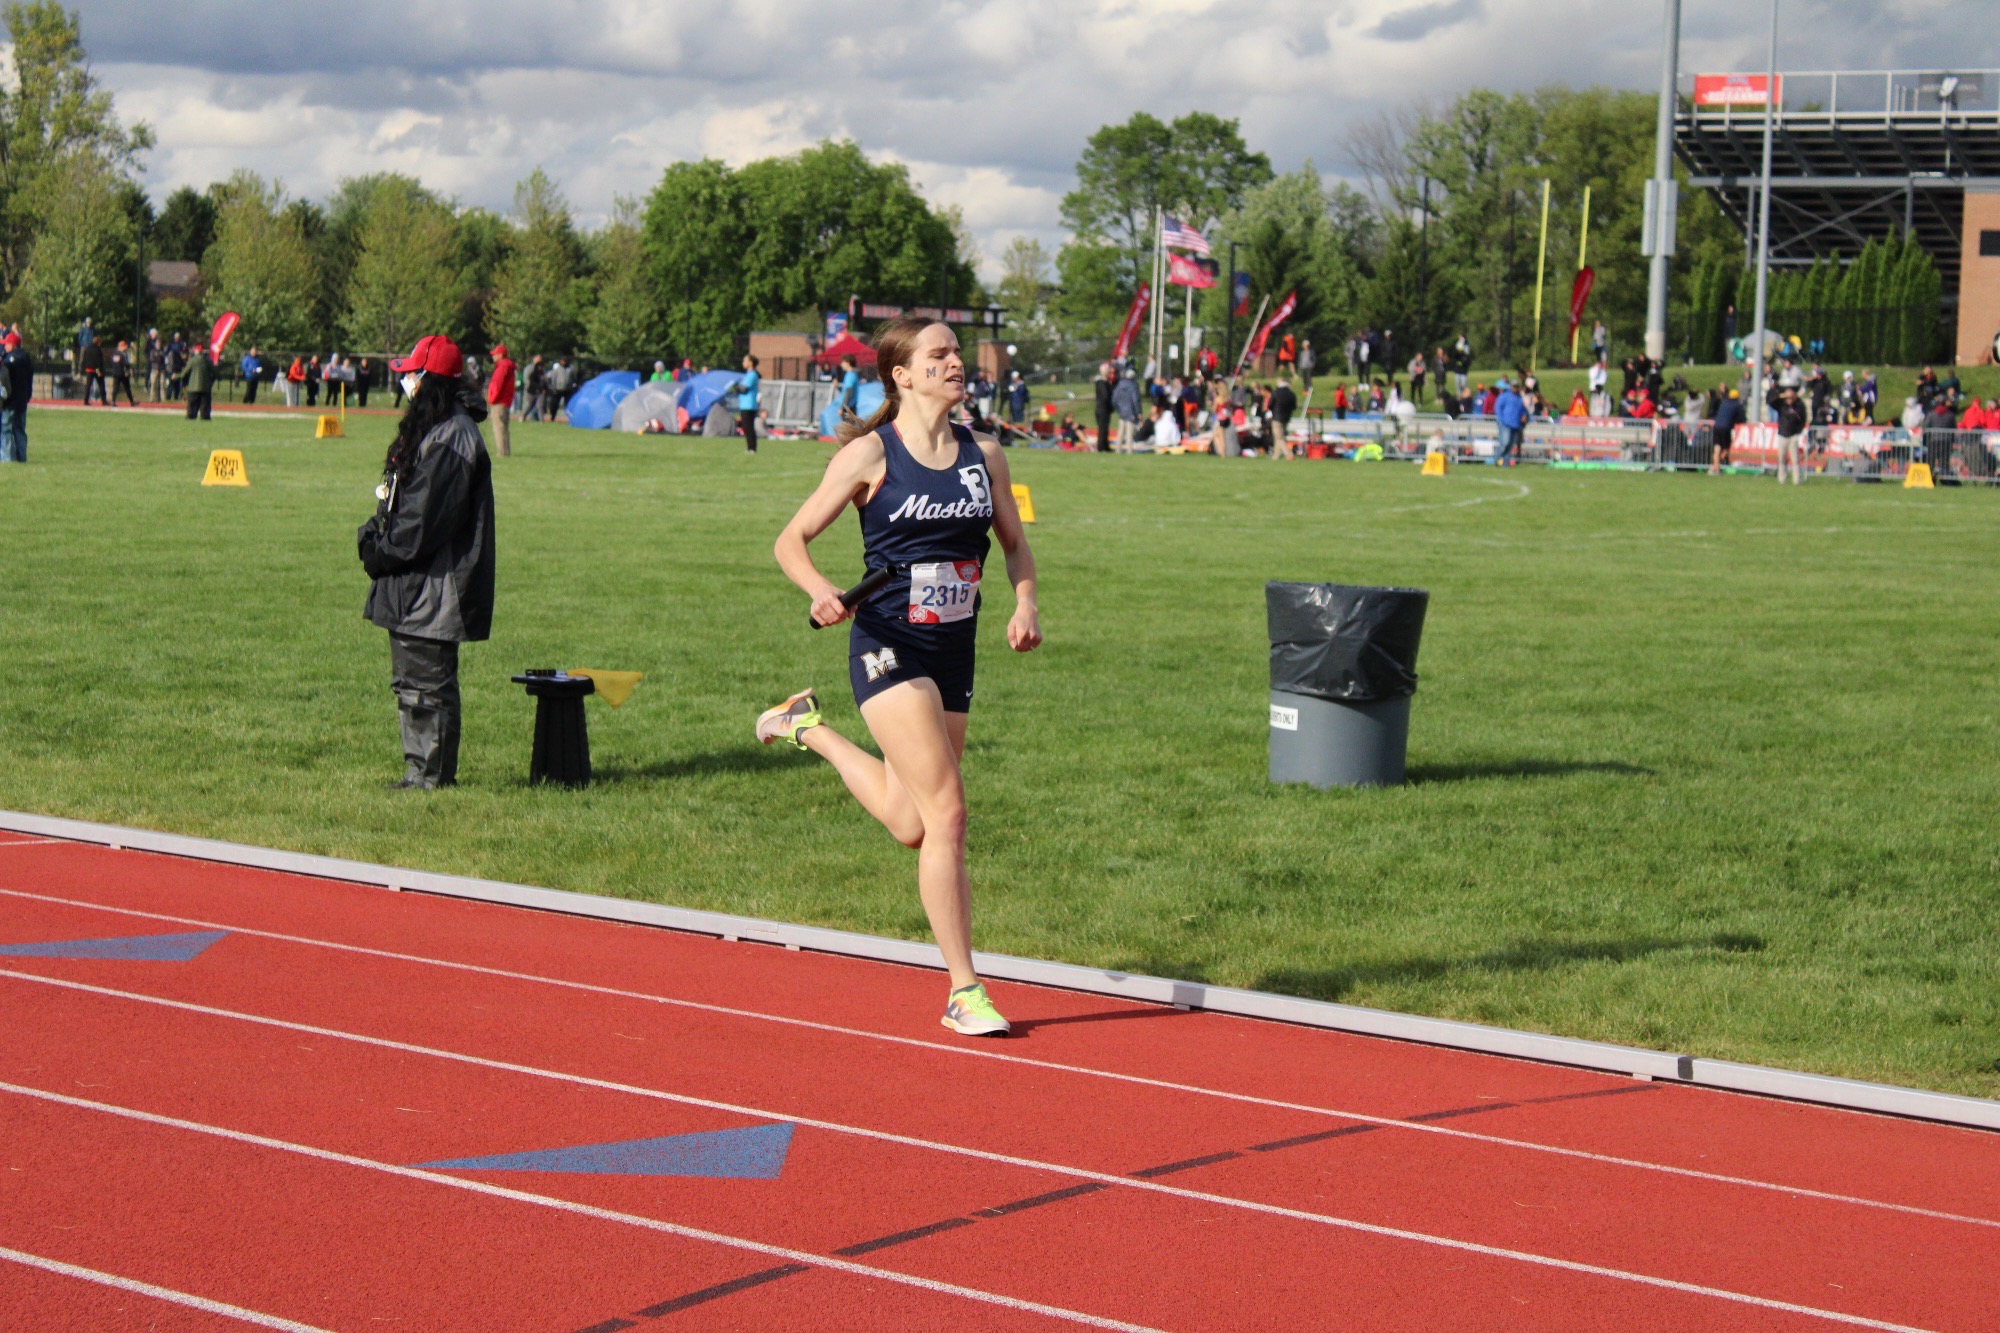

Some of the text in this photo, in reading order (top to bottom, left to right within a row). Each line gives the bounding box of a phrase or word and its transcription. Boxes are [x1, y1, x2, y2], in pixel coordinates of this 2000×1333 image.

[926, 366, 937, 378] M
[213, 456, 239, 470] 50m
[214, 466, 235, 477] 164
[967, 467, 989, 504] 3
[922, 583, 970, 606] 2315
[860, 647, 902, 682] M
